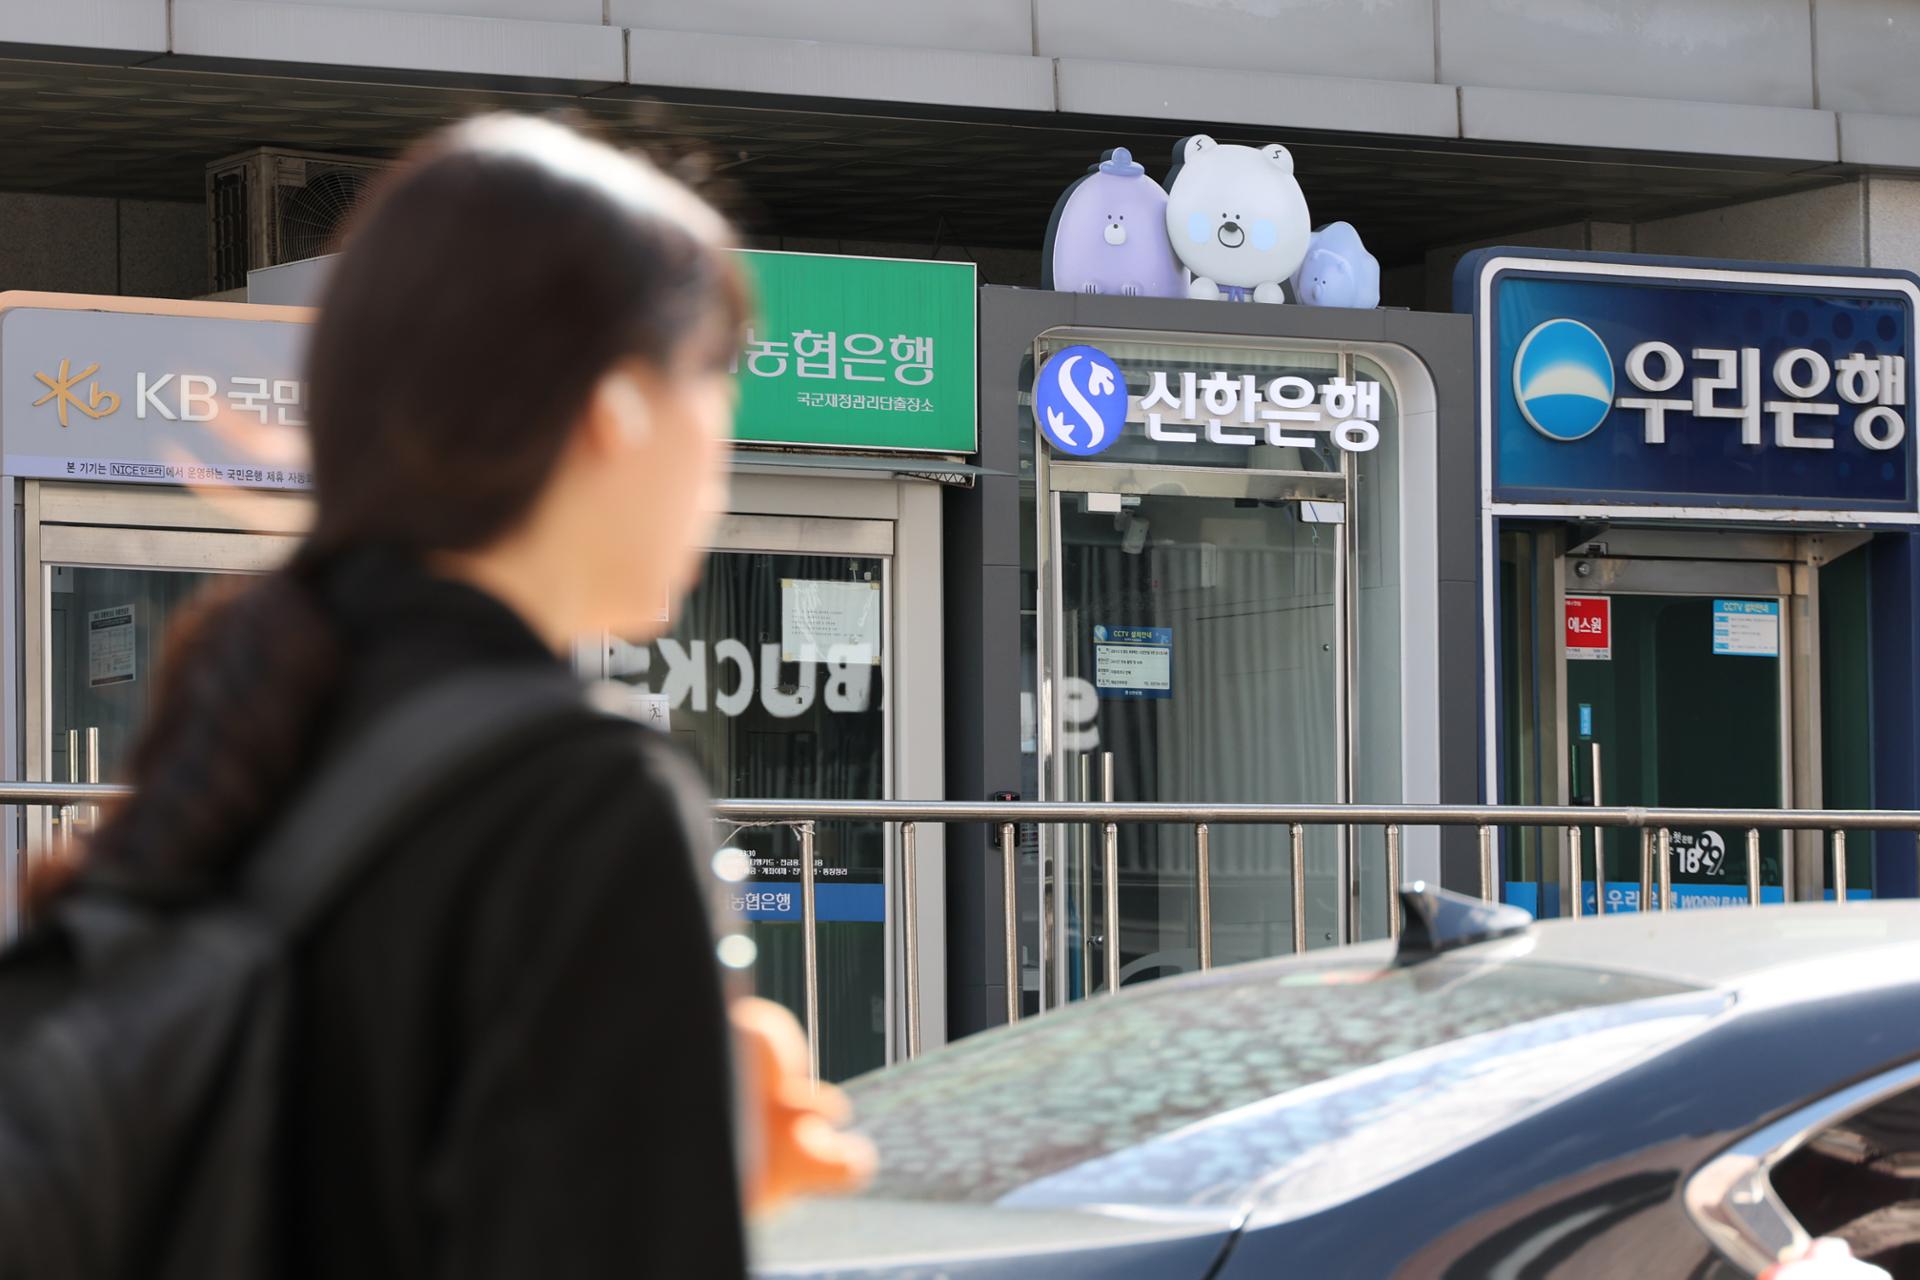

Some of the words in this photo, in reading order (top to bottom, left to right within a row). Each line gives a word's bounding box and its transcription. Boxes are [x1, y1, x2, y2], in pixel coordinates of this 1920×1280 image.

[729, 328, 935, 386] 농협은행
[136, 371, 310, 426] KB국민
[797, 391, 934, 413] 국군재정관리단출장소
[1139, 371, 1381, 452] 신한은행
[1615, 341, 1906, 451] 우리은행
[66, 461, 76, 474] 본
[79, 462, 107, 475] 기기는
[187, 466, 223, 480] 운영하는
[227, 468, 263, 482] 국민은행
[266, 470, 284, 483] 제휴
[1113, 630, 1129, 638] CCTV
[1567, 616, 1602, 634] 에스원
